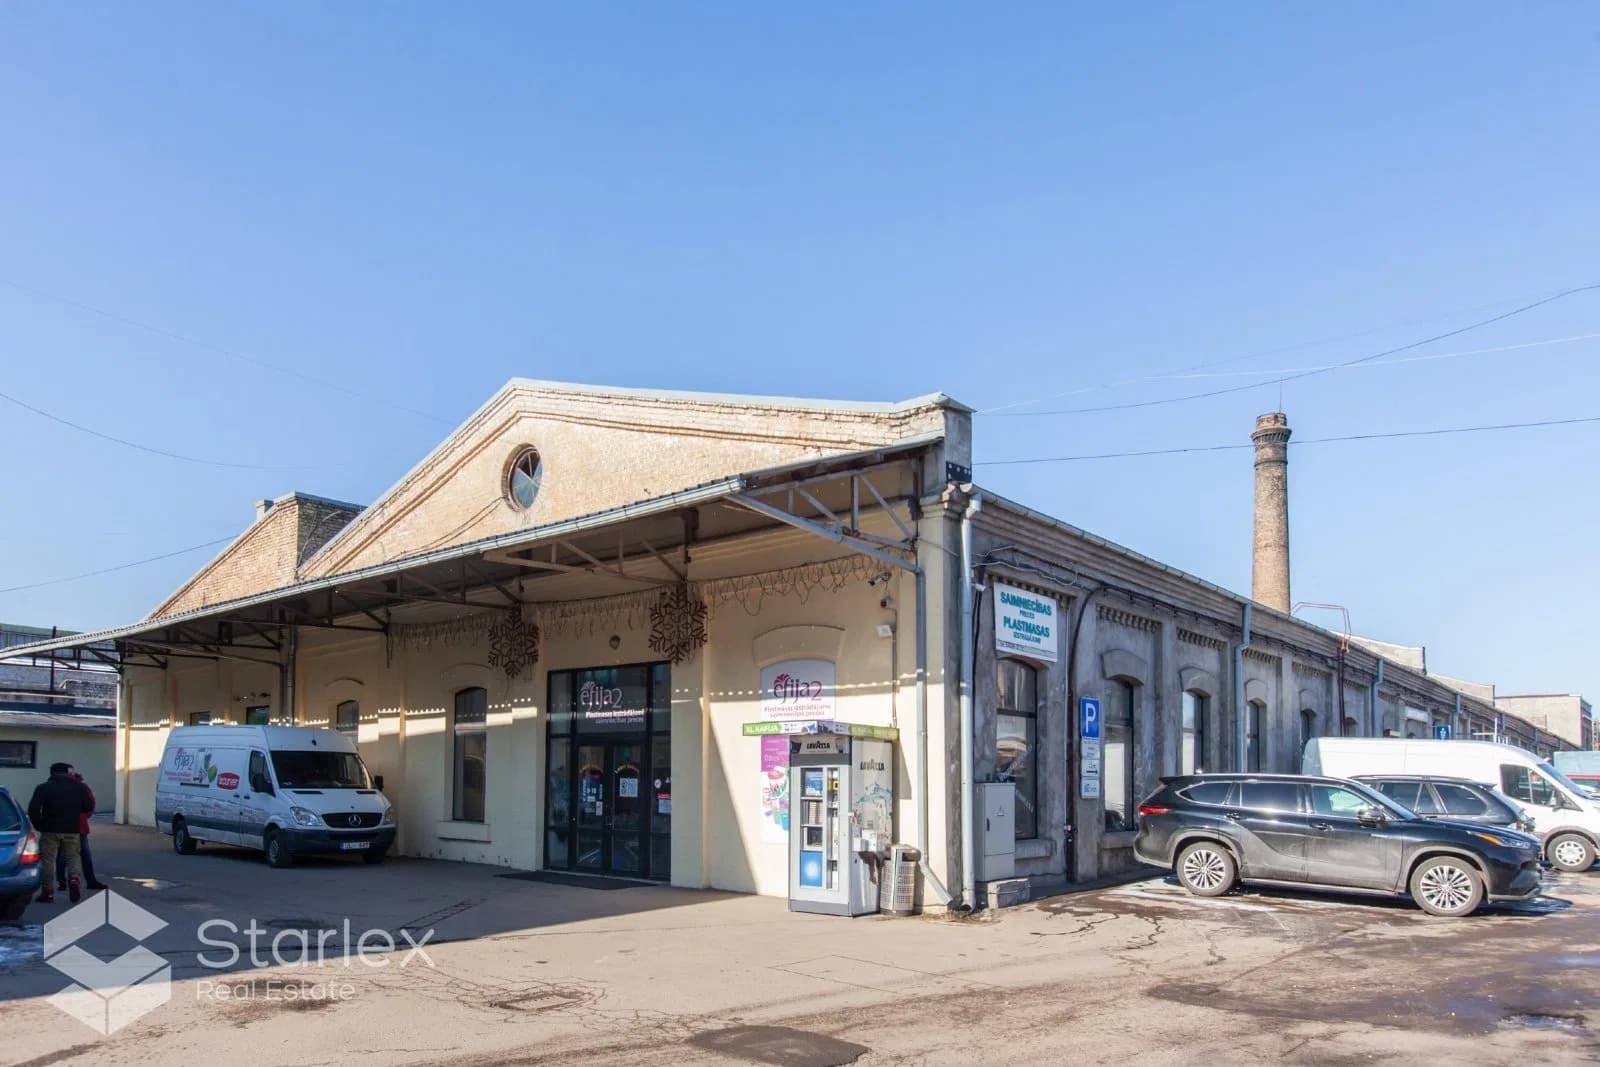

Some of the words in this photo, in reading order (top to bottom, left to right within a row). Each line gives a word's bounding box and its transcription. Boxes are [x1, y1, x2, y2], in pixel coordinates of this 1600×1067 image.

[1003, 616, 1050, 638] PLASTMASAS
[773, 677, 822, 704] efija2
[1085, 702, 1097, 733] P
